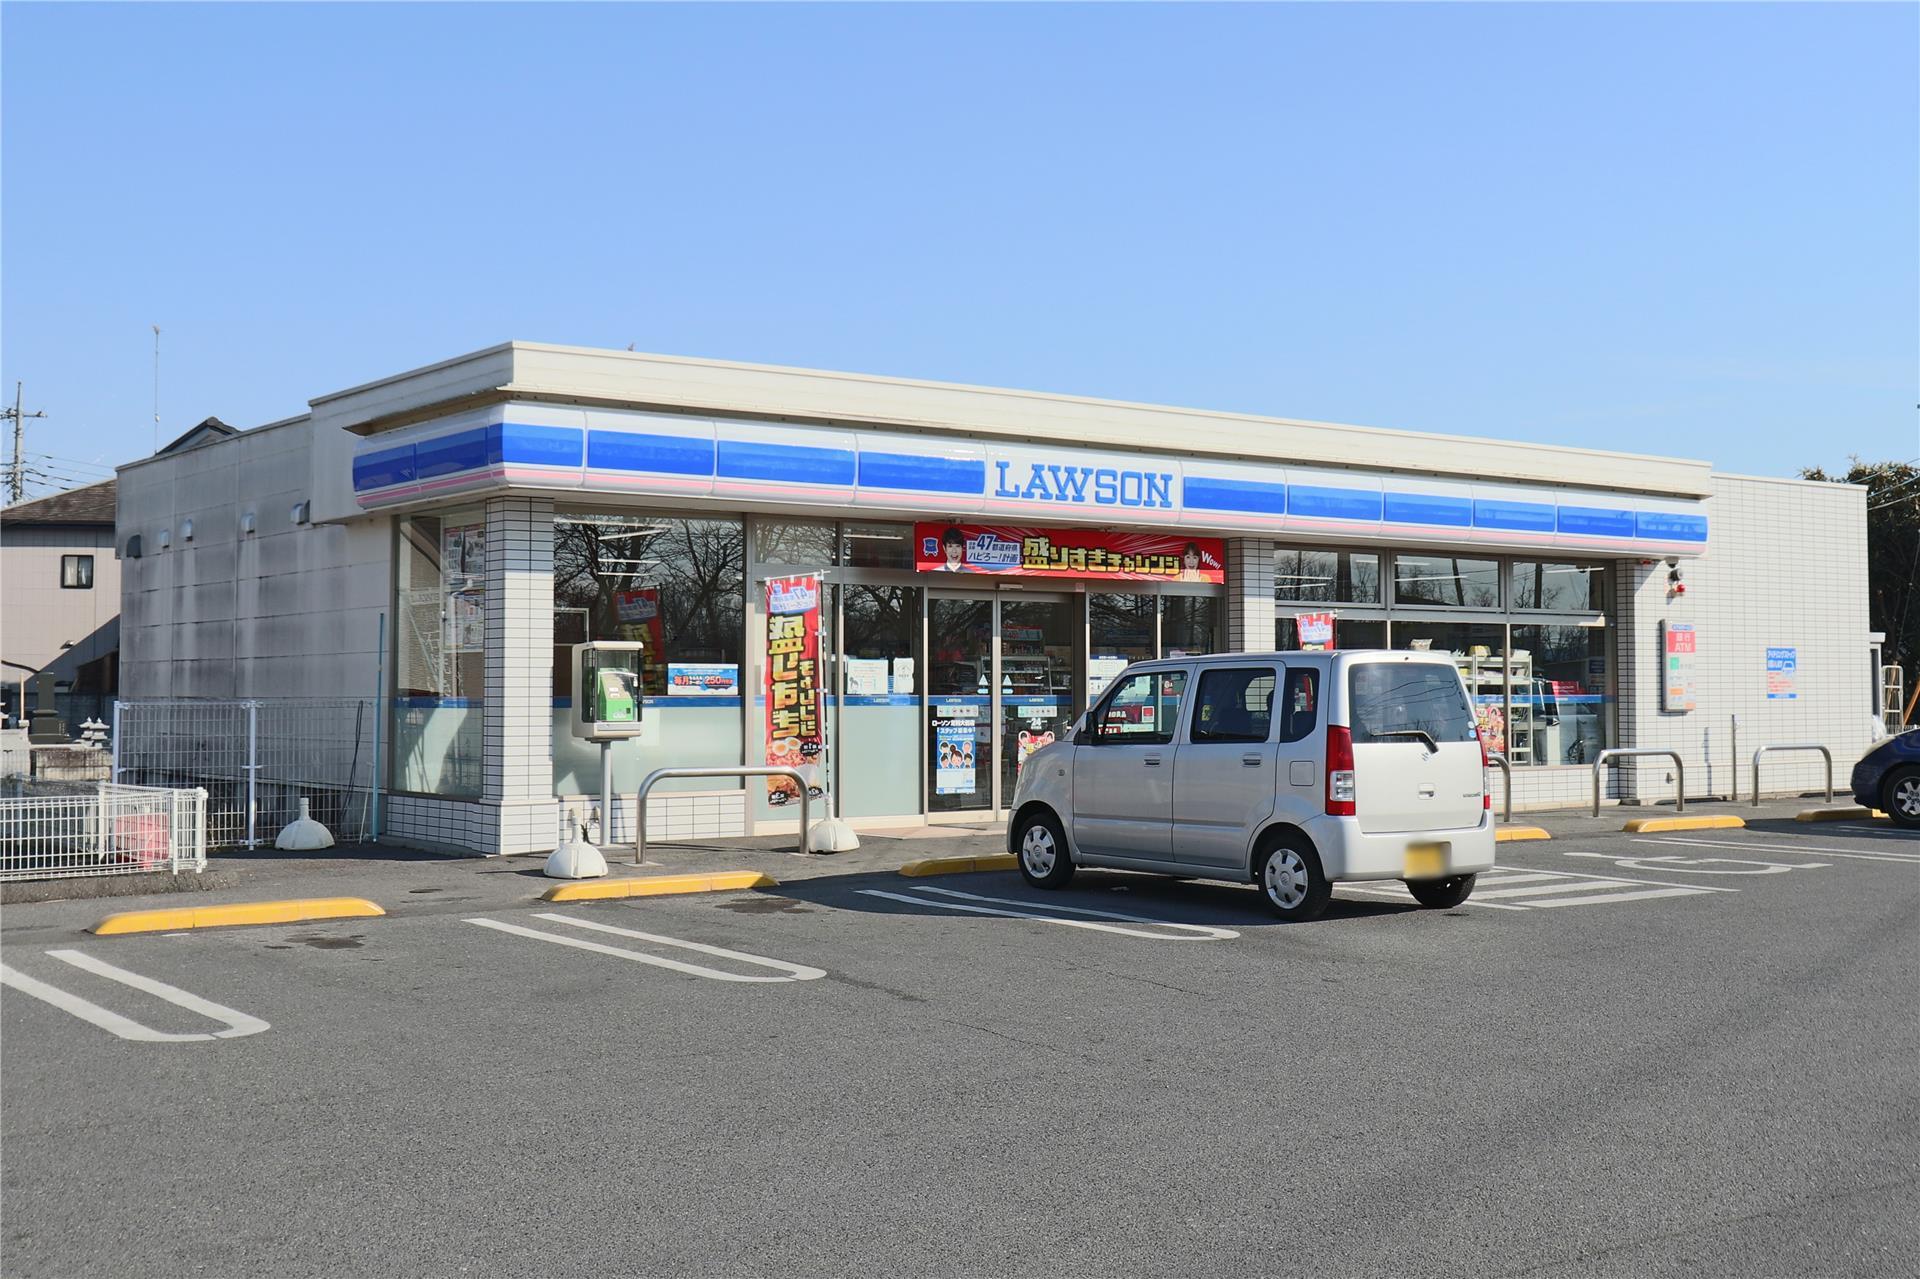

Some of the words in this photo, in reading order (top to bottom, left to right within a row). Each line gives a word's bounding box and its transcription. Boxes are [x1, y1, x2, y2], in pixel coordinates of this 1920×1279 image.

[995, 460, 1173, 508] LAWSON
[1022, 536, 1181, 574] 盛りすぎチャレンジ
[1674, 642, 1691, 652] ATM
